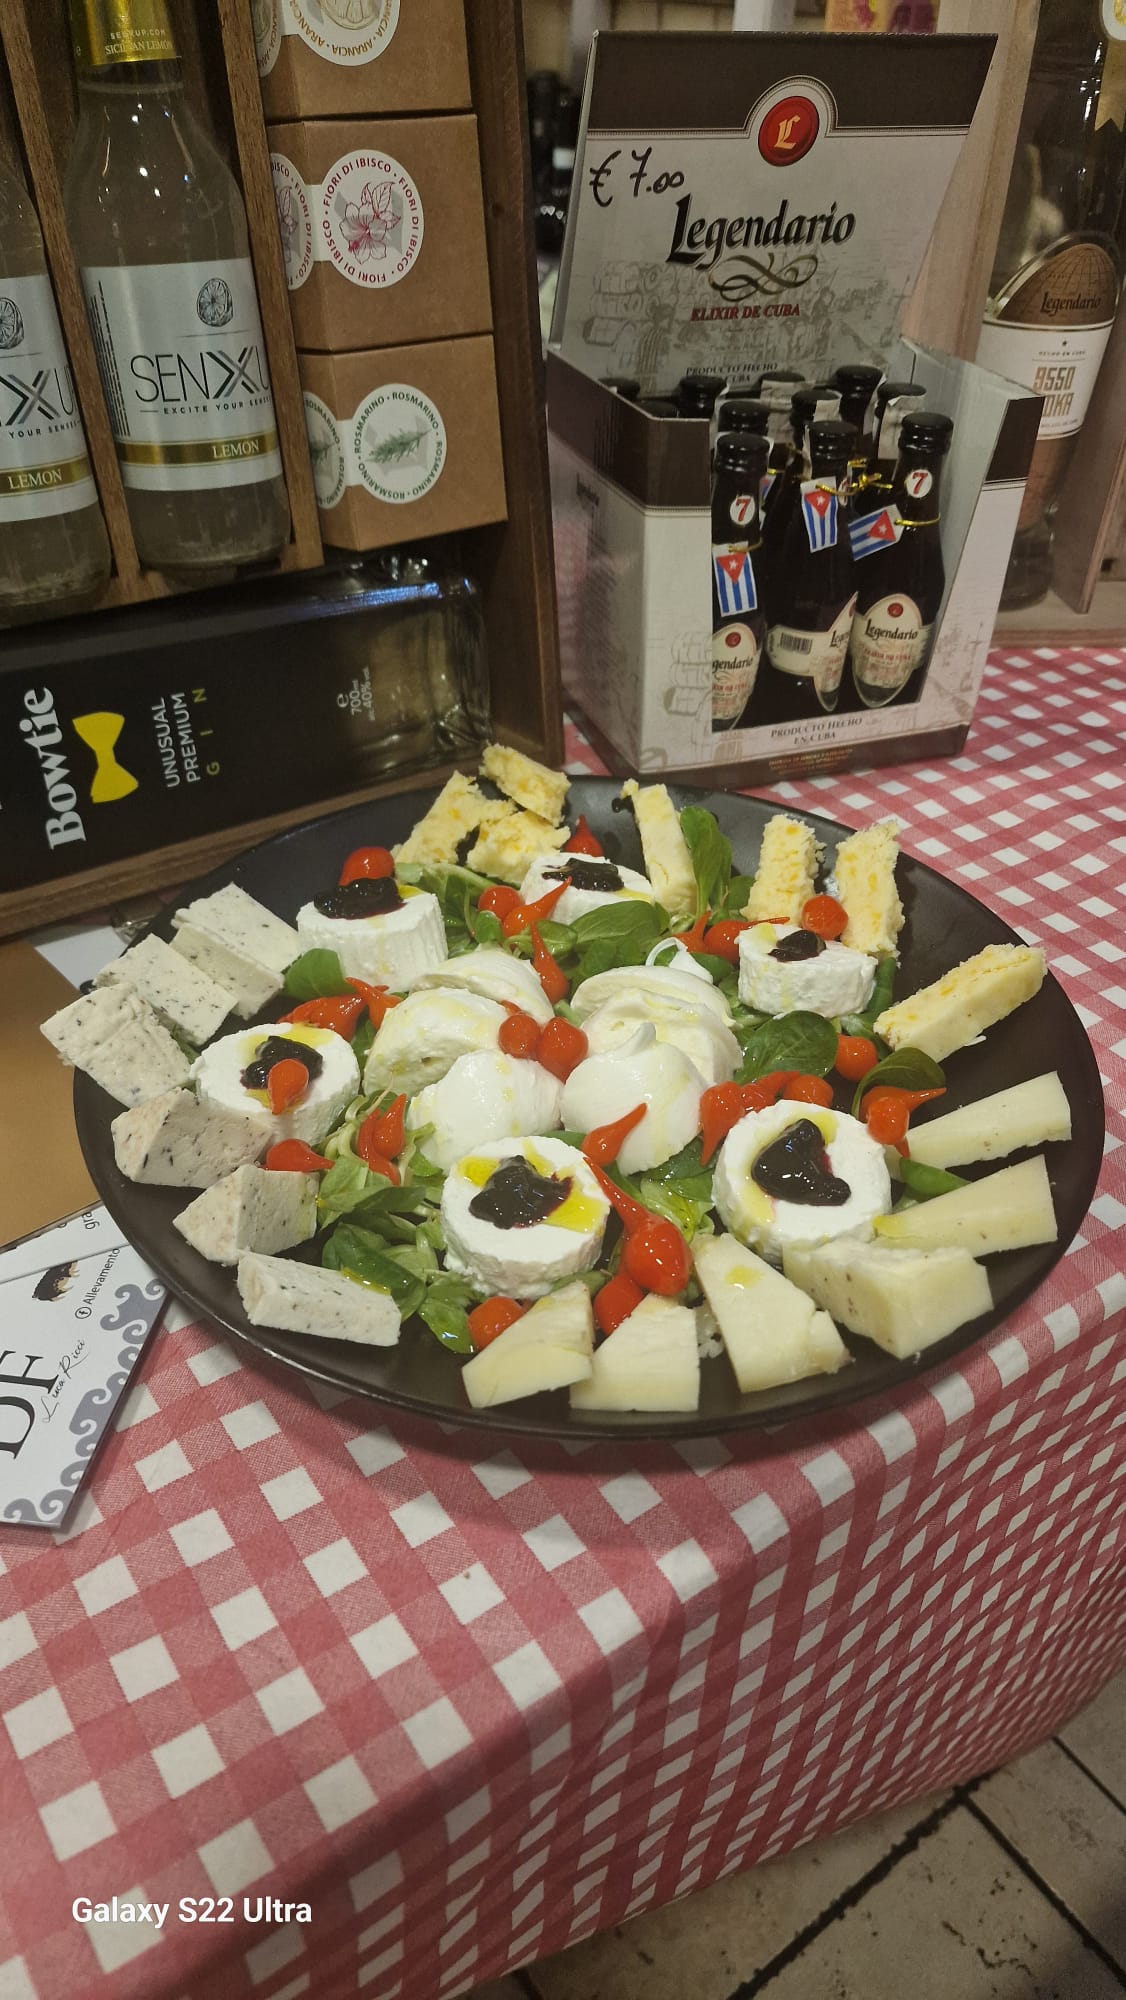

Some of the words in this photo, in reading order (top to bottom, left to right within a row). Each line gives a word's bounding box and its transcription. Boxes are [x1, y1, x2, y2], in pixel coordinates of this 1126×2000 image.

[104, 41, 145, 55] SICILAN
[323, 173, 343, 207] FIORI
[341, 161, 354, 176] DI
[355, 157, 391, 173] IBISCO
[398, 176, 418, 212] FIORI
[411, 216, 419, 231] DI
[666, 192, 856, 271] Legendario
[322, 220, 344, 264] IBISCO
[397, 234, 419, 272] IBISCO
[343, 263, 355, 276] DI
[357, 271, 387, 283] FIORI
[690, 305, 740, 322] ELIXIR
[742, 305, 761, 319] DE
[763, 303, 800, 318] CUBA
[1040, 291, 1102, 317] Legendario
[130, 345, 270, 403] SENXU
[164, 405, 208, 415] EXCITE
[216, 402, 244, 411] YOUR
[392, 391, 439, 429] ROSMARINO
[1042, 392, 1075, 417] DKA
[9, 428, 42, 440] YOUR
[354, 395, 385, 454] ROSMARINO
[212, 440, 260, 459] LEMON
[8, 468, 63, 490] LEMON
[358, 462, 405, 500] ROSMARINO
[412, 441, 443, 496] ROSMARINO
[912, 471, 928, 495] 7
[736, 498, 750, 523] 7
[865, 618, 918, 641] Legendario
[712, 657, 754, 674] gendario
[152, 697, 181, 788] UNUSUAL
[171, 692, 201, 783] PREMIUM
[19, 686, 86, 850] Bowtie
[83, 1248, 120, 1305] Allevamento
[41, 1380, 66, 1423] Luca
